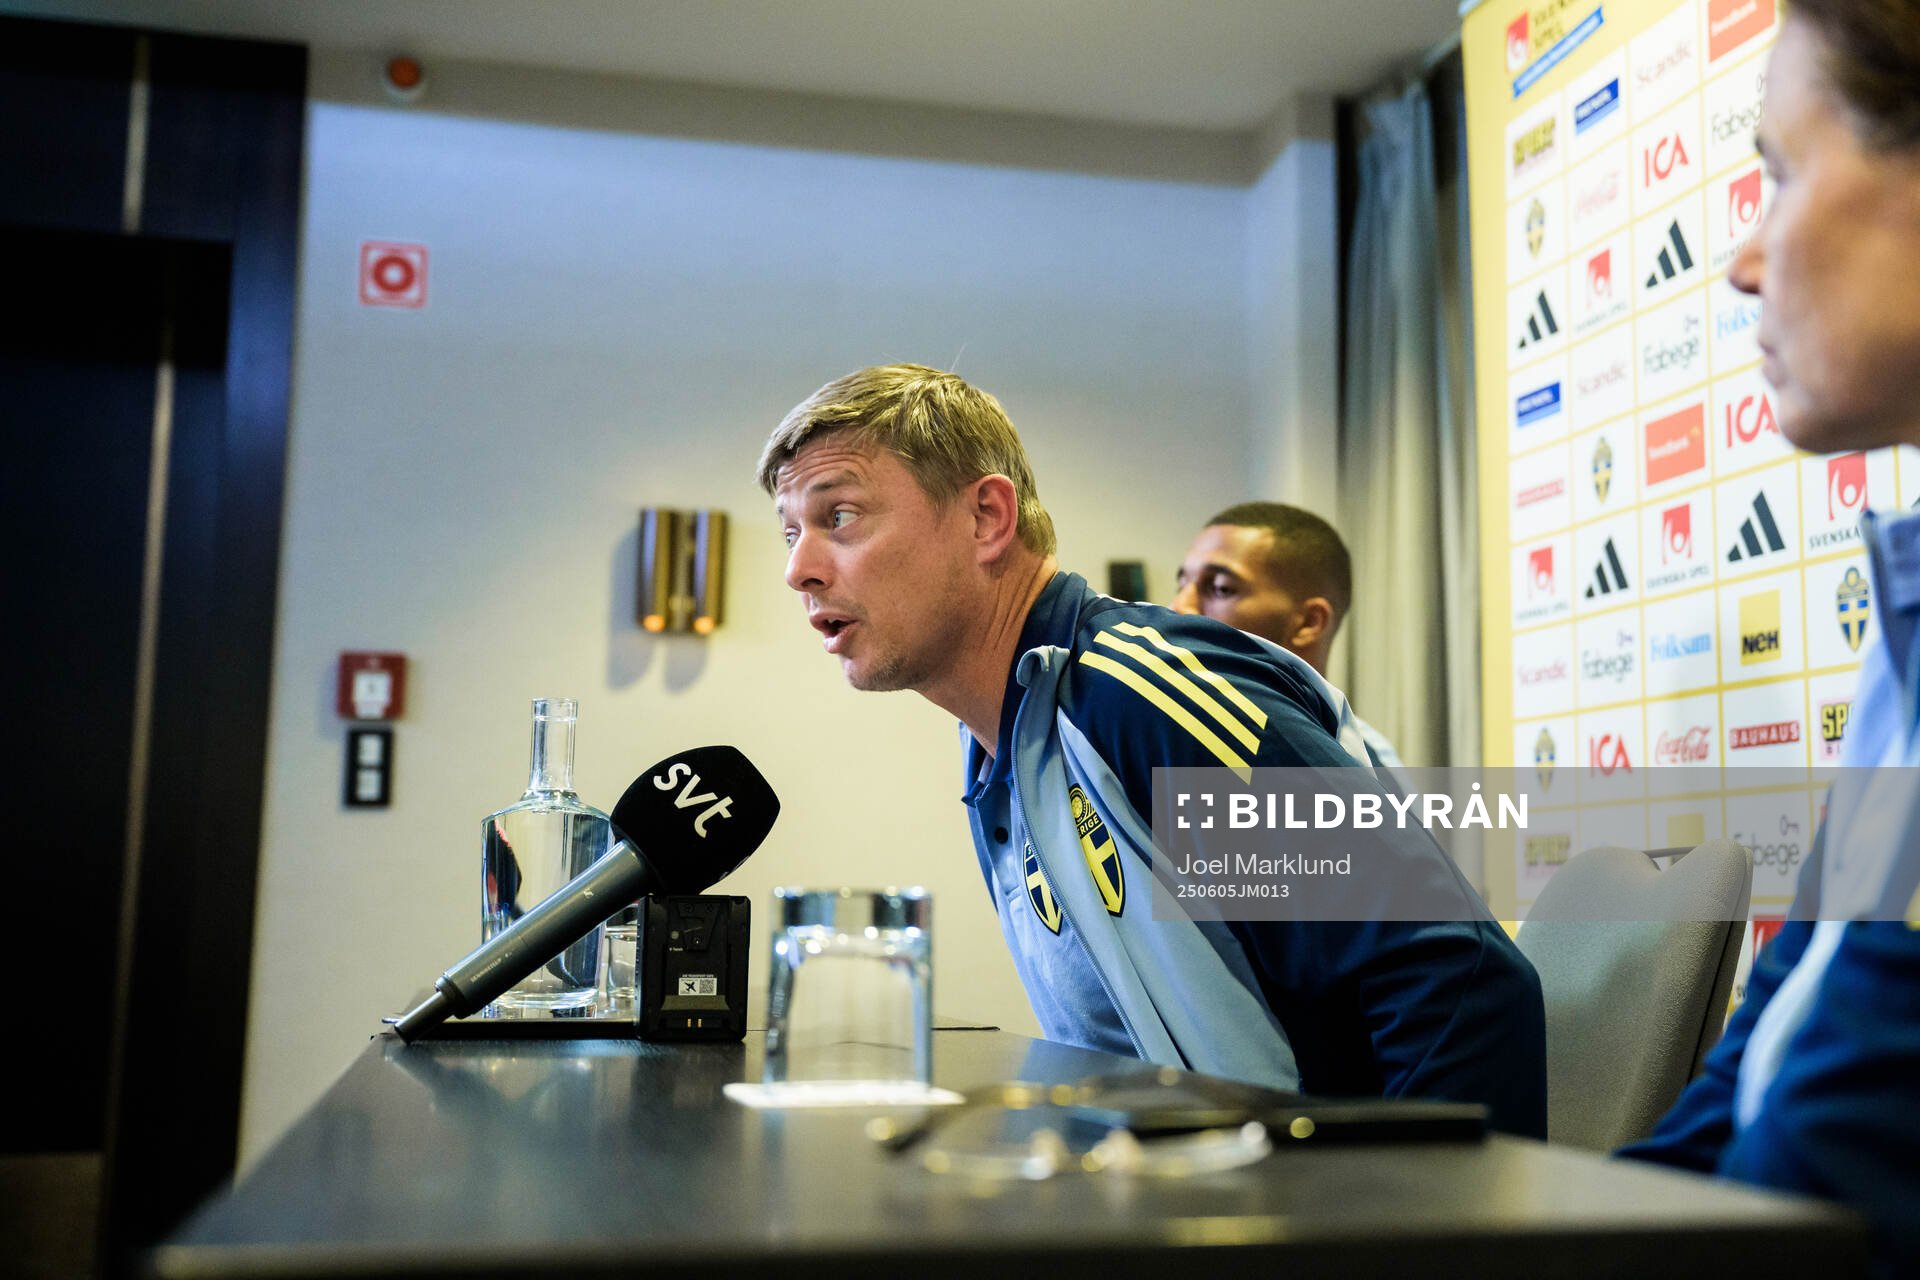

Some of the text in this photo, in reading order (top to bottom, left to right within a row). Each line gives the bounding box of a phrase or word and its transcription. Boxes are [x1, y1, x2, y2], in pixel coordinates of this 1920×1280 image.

[1644, 131, 1689, 189] ICA
[1725, 392, 1780, 449] ICA
[1809, 525, 1861, 550] SVENSKA
[1729, 721, 1799, 750] BAUHAUS
[1821, 702, 1853, 740] SP
[1588, 733, 1633, 779] ICA
[653, 762, 734, 839] svt
[1077, 813, 1100, 836] RIGE
